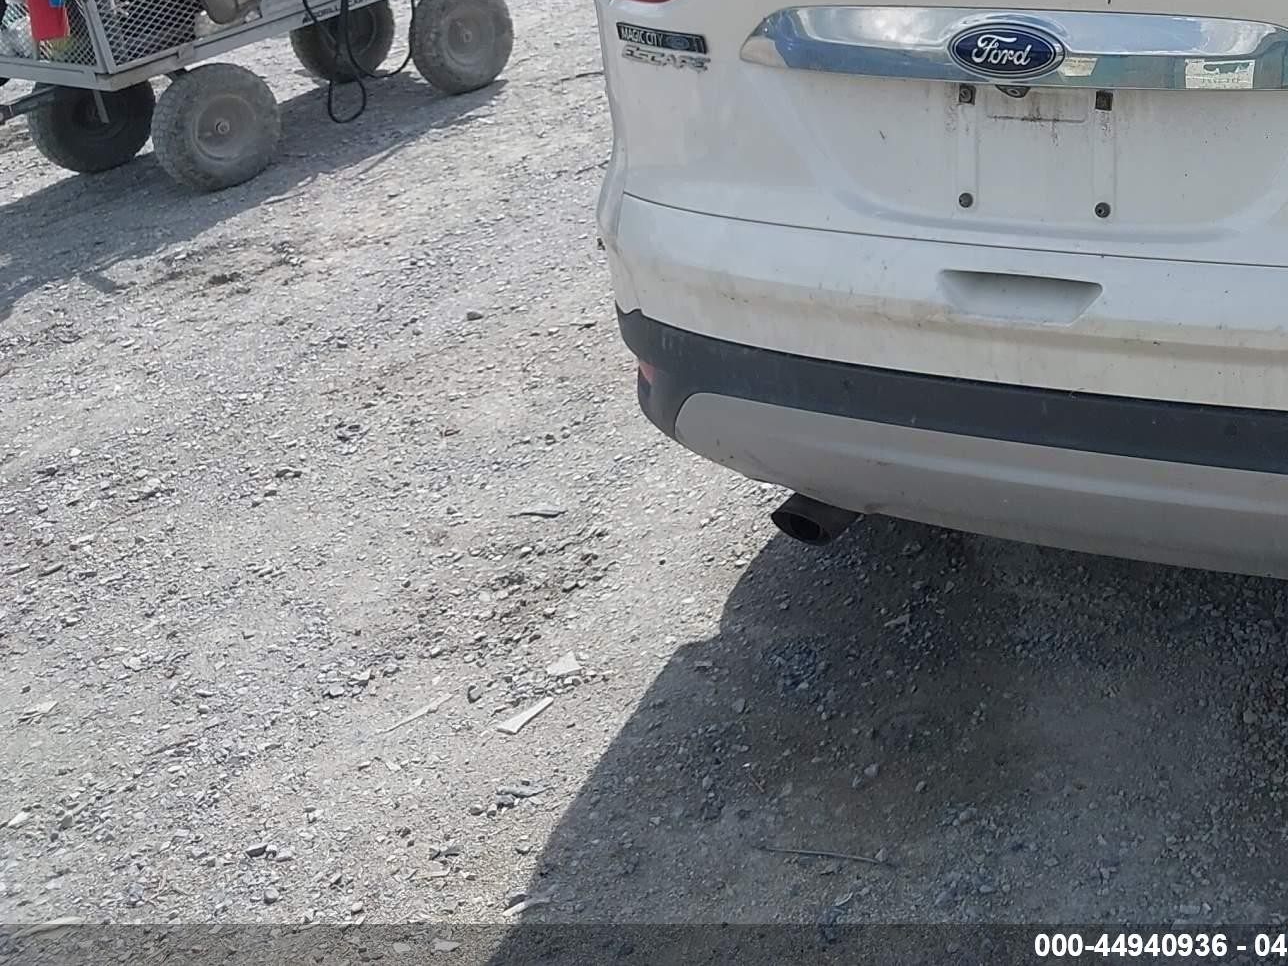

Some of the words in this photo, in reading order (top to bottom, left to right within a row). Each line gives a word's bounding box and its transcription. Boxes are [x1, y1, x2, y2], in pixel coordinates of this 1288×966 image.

[621, 25, 645, 44] MAGIC
[646, 32, 664, 47] CITY
[971, 34, 1033, 66] Ford
